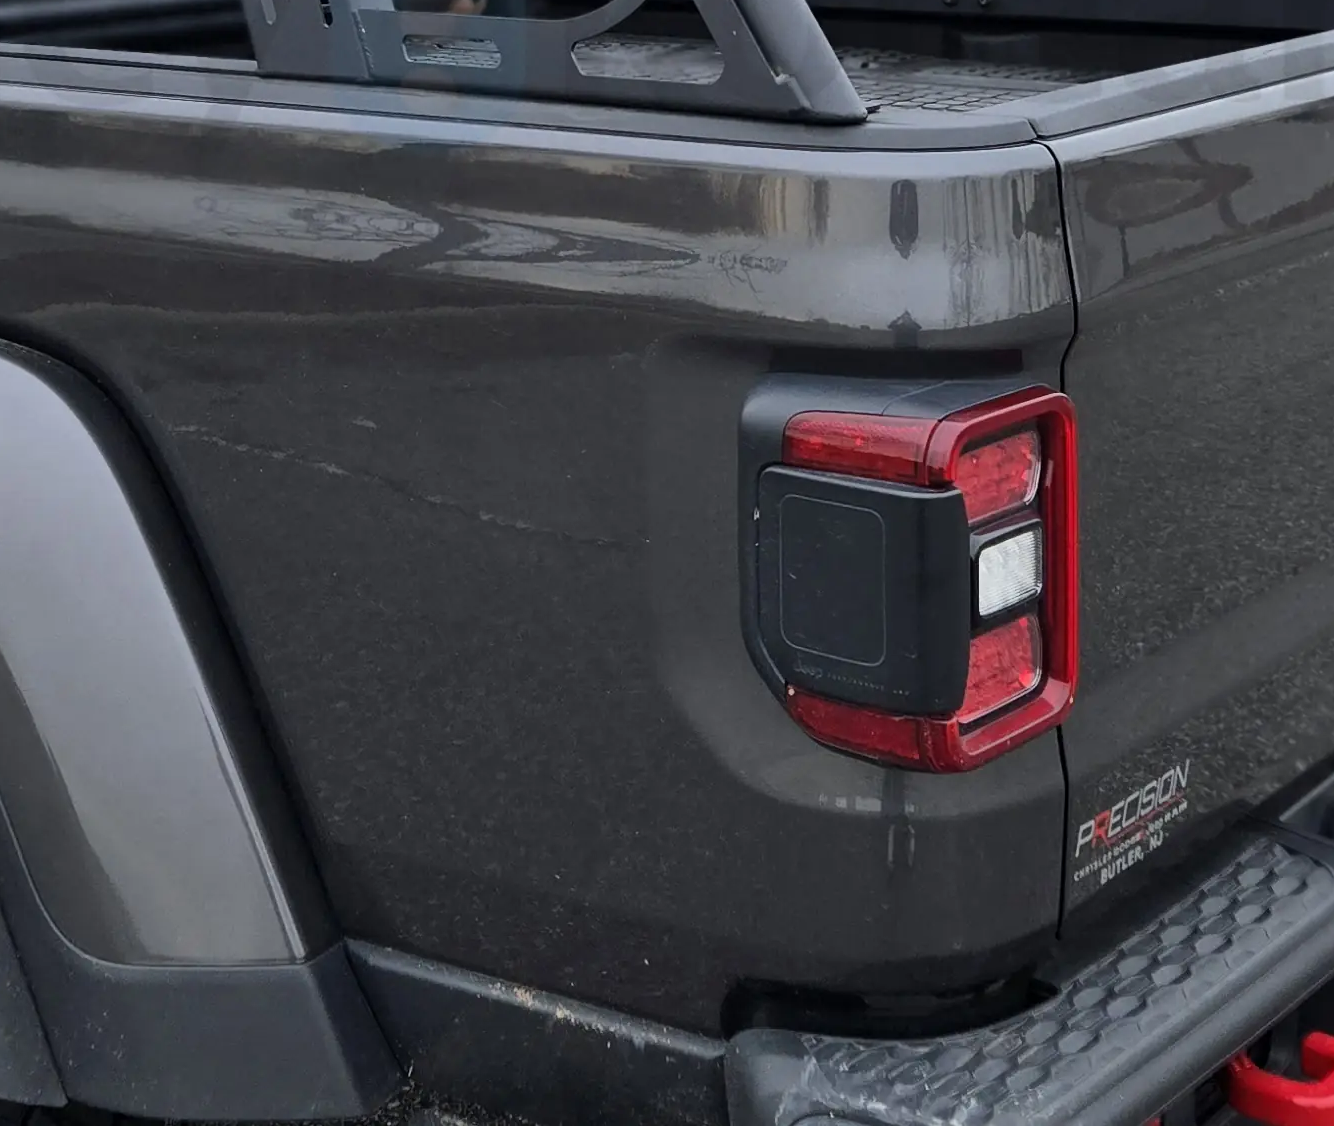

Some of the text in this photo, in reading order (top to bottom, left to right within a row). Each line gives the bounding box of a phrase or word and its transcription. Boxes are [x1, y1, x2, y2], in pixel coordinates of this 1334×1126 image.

[1075, 758, 1190, 858] PRECISION
[1100, 830, 1163, 885] BUTLER, NJ
